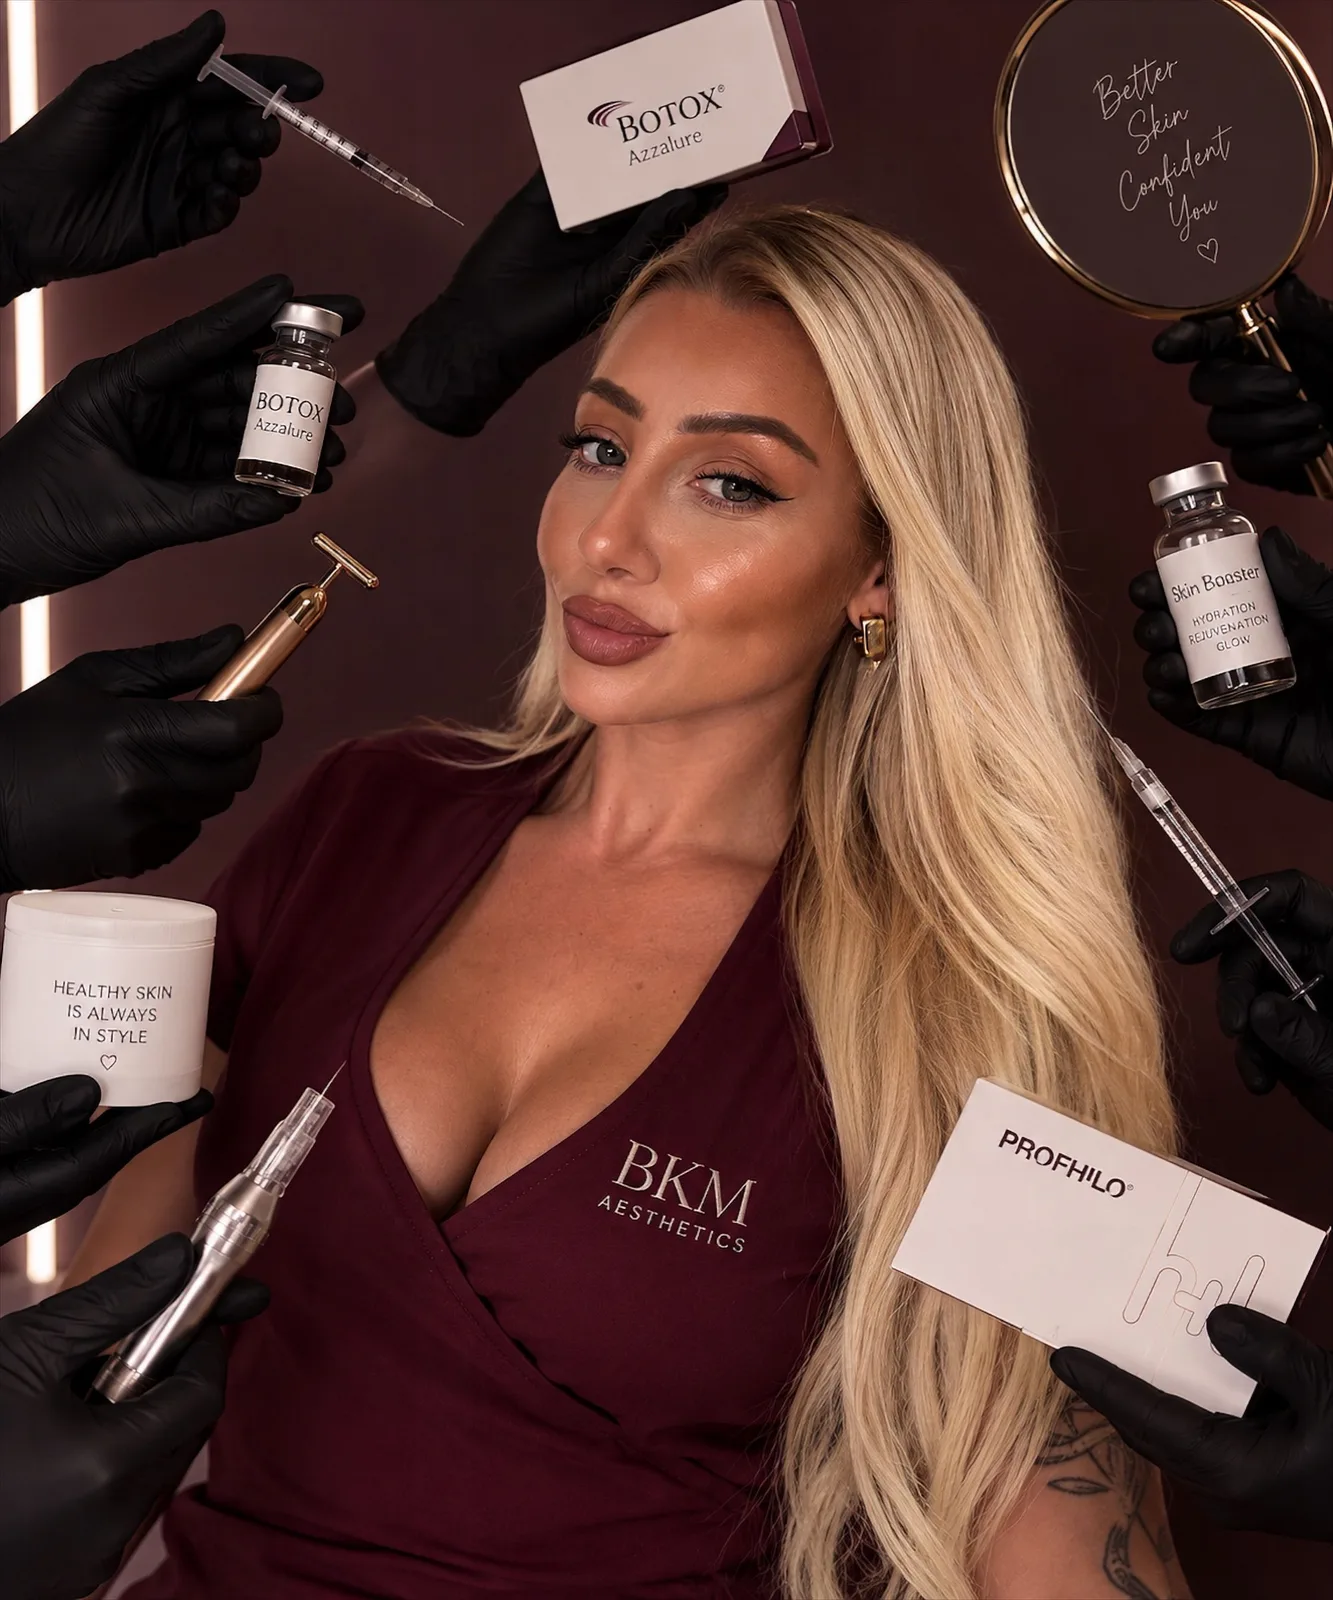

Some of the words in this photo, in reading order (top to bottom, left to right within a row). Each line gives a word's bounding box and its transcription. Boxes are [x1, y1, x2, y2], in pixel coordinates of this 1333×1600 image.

[1092, 58, 1178, 120] Better
[1127, 104, 1189, 155] Skin
[628, 129, 703, 166] Azzalure
[1119, 125, 1232, 212] Confident
[1168, 194, 1218, 242] You
[256, 392, 324, 424] BOTOX
[254, 418, 314, 442] Azzalure
[1171, 583, 1201, 603] Skin
[1188, 614, 1269, 646] REJUVENATION
[1192, 601, 1256, 627] HYDRATION
[1216, 635, 1251, 652] GLOW
[53, 980, 131, 1000] HEALTHY
[136, 986, 173, 1000] SKIN
[67, 1004, 82, 1019] IS
[87, 1006, 157, 1022] ALWAYS
[73, 1026, 91, 1042] IN
[96, 1028, 148, 1044] STYLE
[611, 1139, 757, 1228] BKM
[597, 1194, 745, 1254] AESTHETICS
